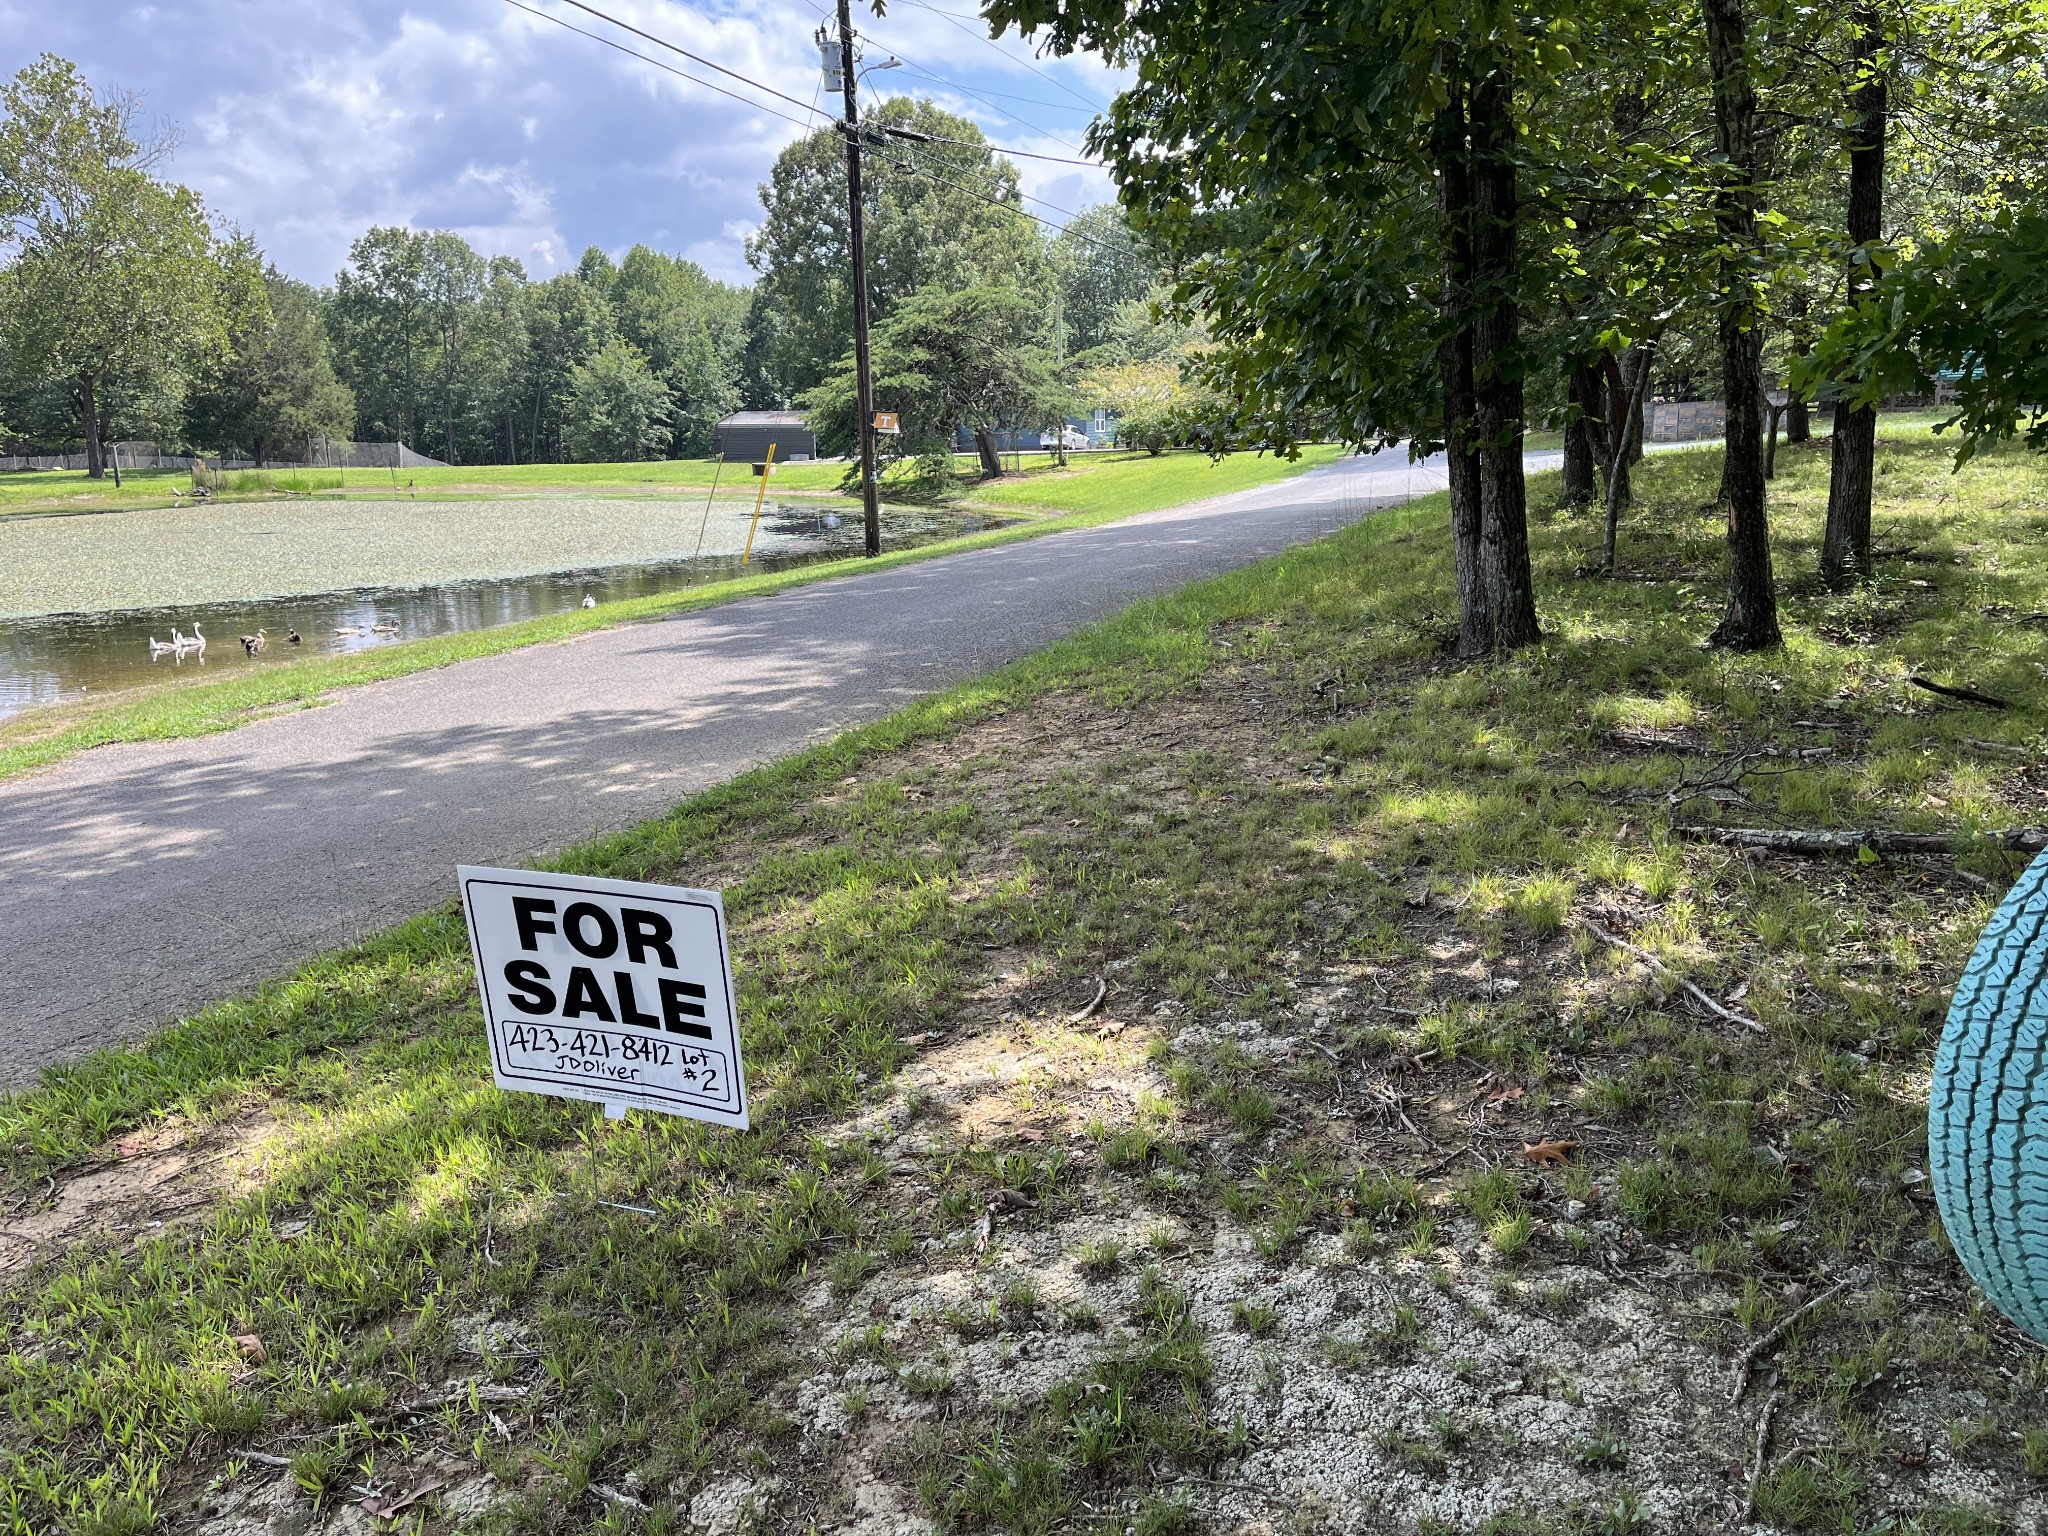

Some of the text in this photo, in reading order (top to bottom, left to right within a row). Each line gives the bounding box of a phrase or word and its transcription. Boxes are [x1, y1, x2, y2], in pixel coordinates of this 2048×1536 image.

[512, 896, 679, 970] FOR
[503, 959, 713, 1041] SALE
[508, 1024, 674, 1066] 423-421-8412
